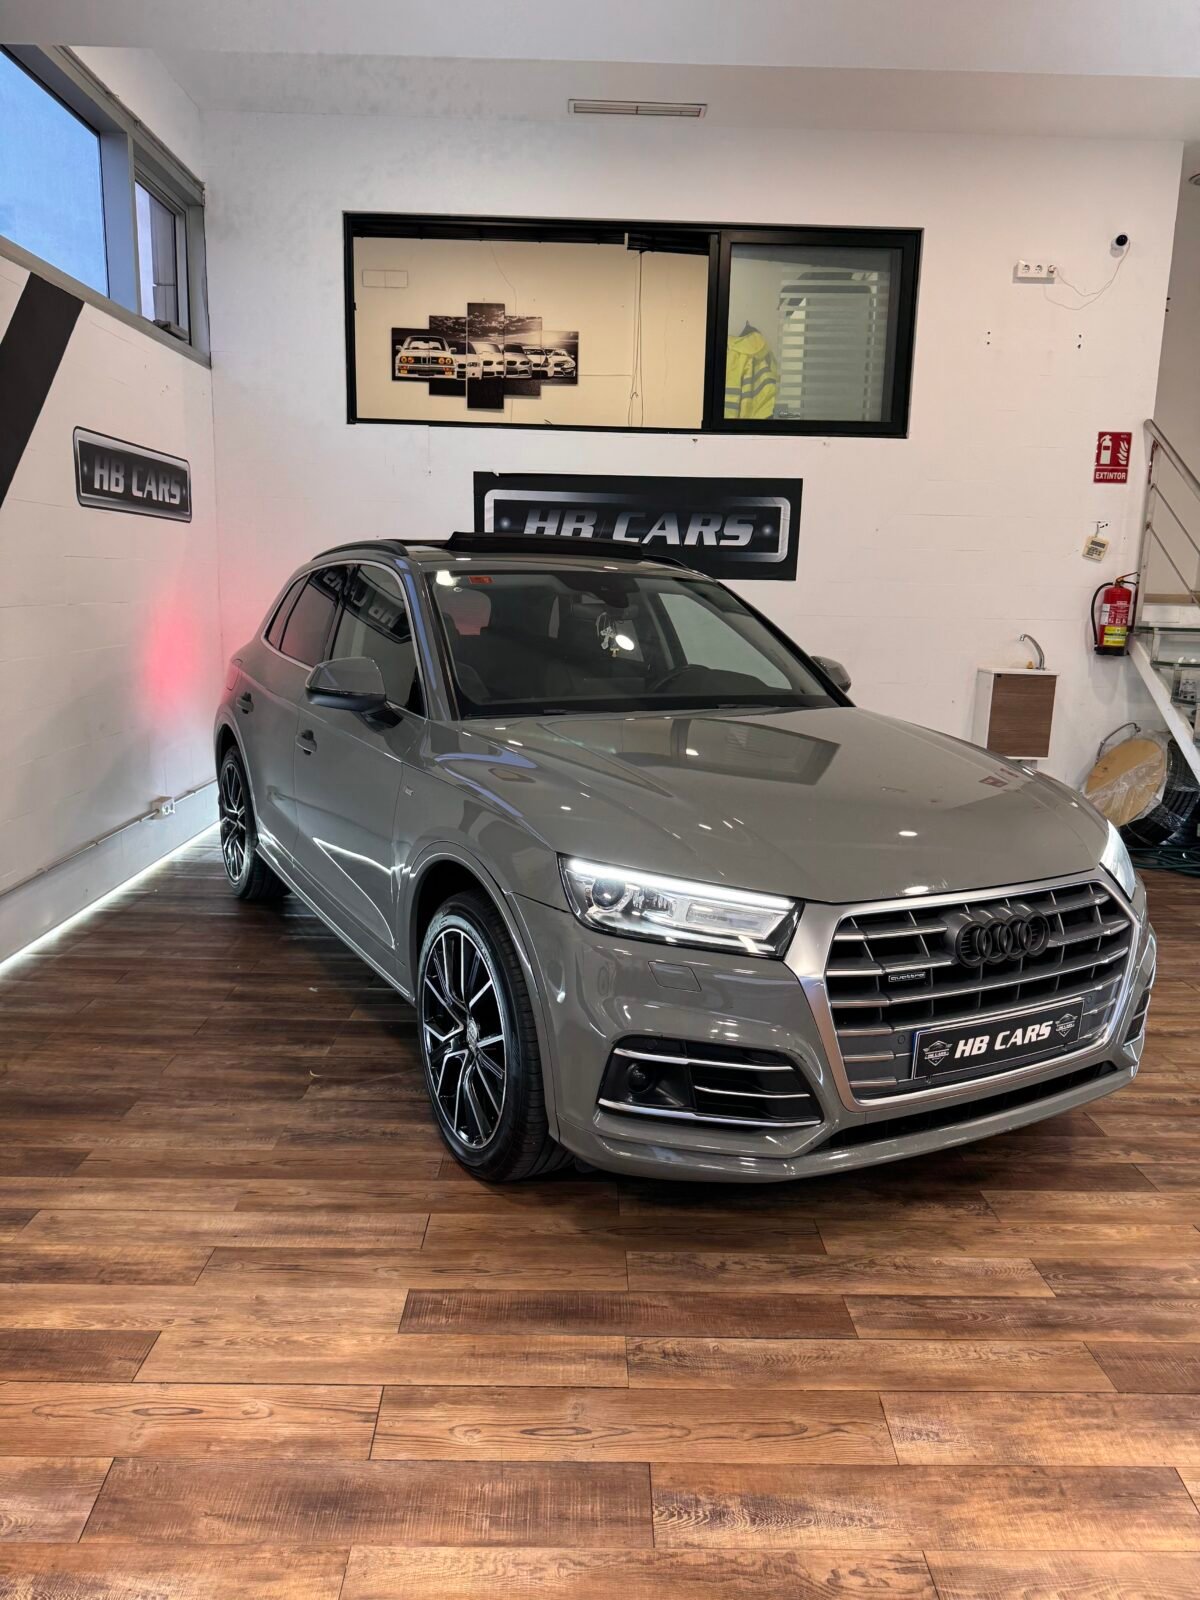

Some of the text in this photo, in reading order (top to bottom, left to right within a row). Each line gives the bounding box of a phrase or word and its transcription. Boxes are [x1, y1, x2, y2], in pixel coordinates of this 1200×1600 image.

[94, 455, 181, 504] HB CARS
[1095, 471, 1127, 480] EXTINTOR
[612, 511, 757, 547] CARS
[890, 972, 925, 982] quattro
[954, 1020, 1053, 1059] HB CARS
